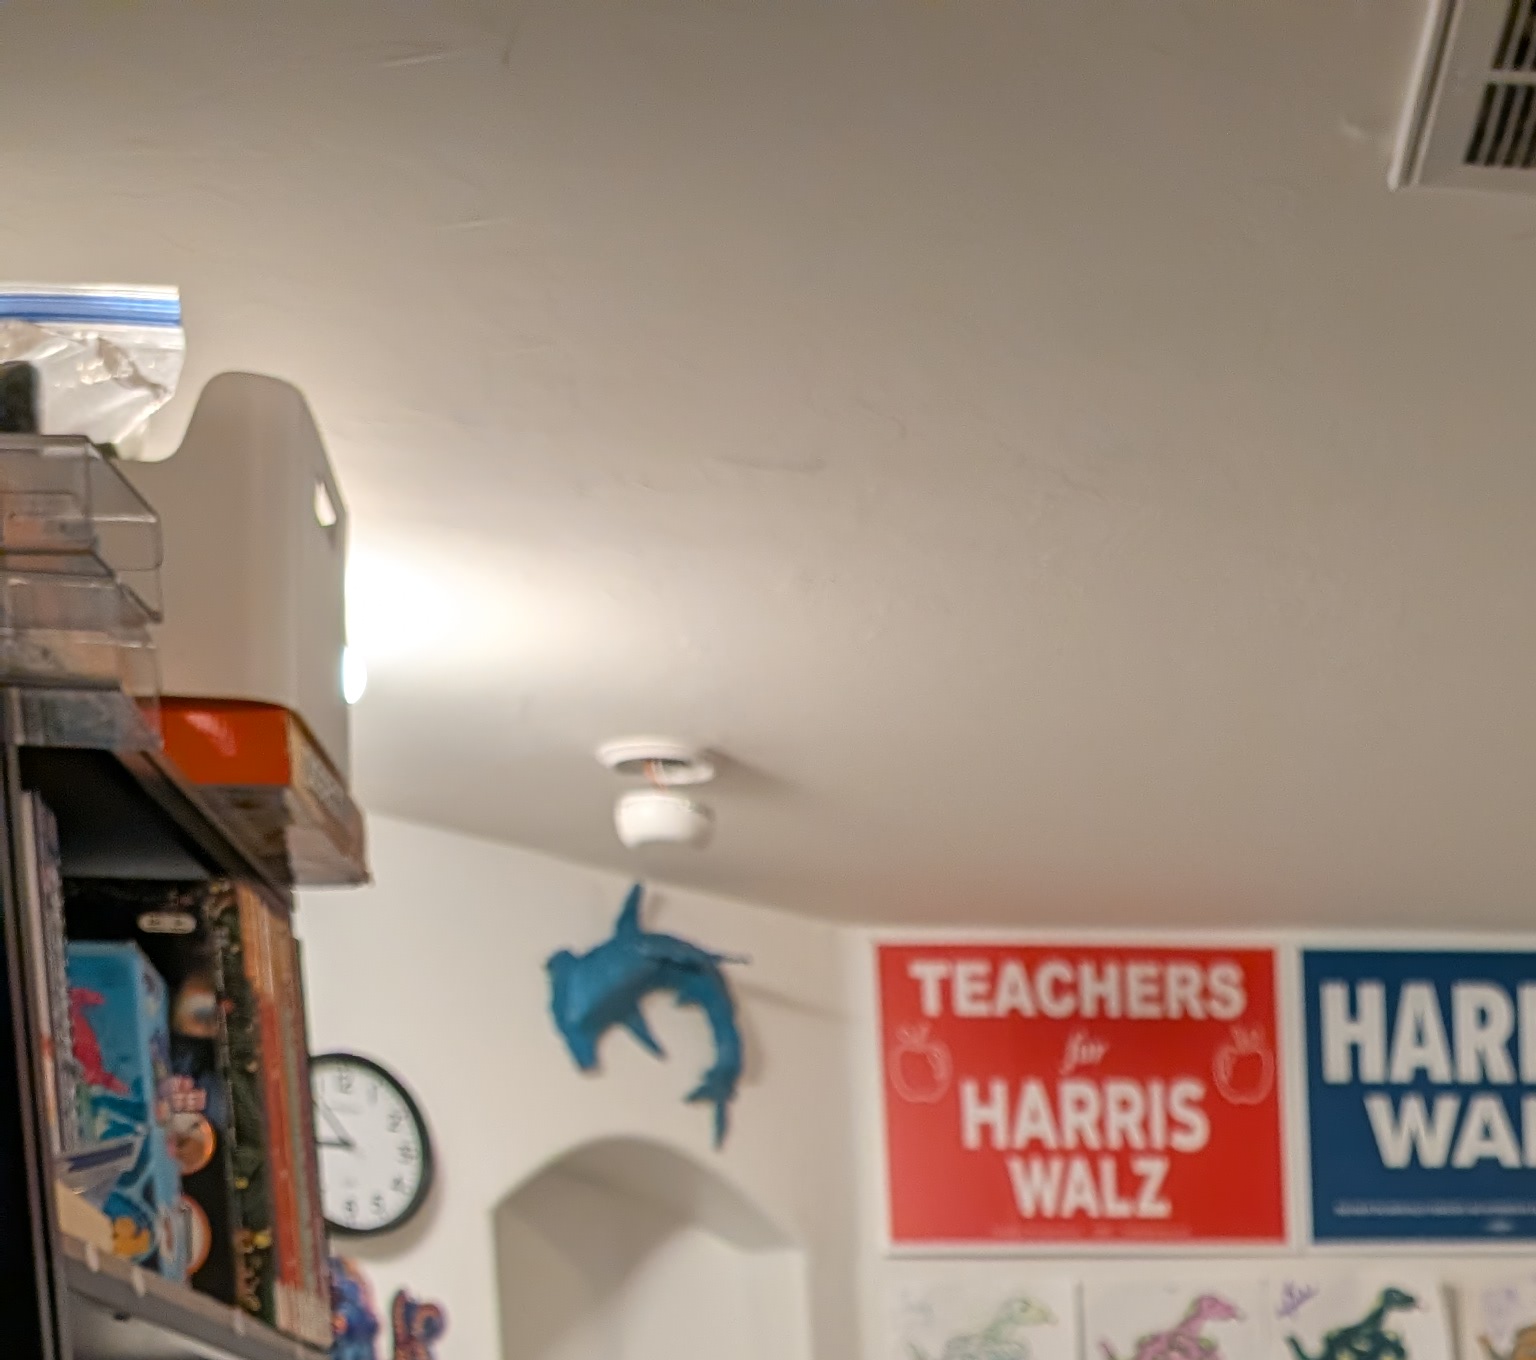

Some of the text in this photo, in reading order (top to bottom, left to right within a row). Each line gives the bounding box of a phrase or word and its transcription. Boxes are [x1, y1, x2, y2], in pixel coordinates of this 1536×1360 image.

[907, 959, 1247, 1019] TEACHERS
[1060, 1030, 1109, 1074] for
[959, 1078, 1211, 1152] HARRIS
[1007, 1156, 1172, 1219] WALZ
